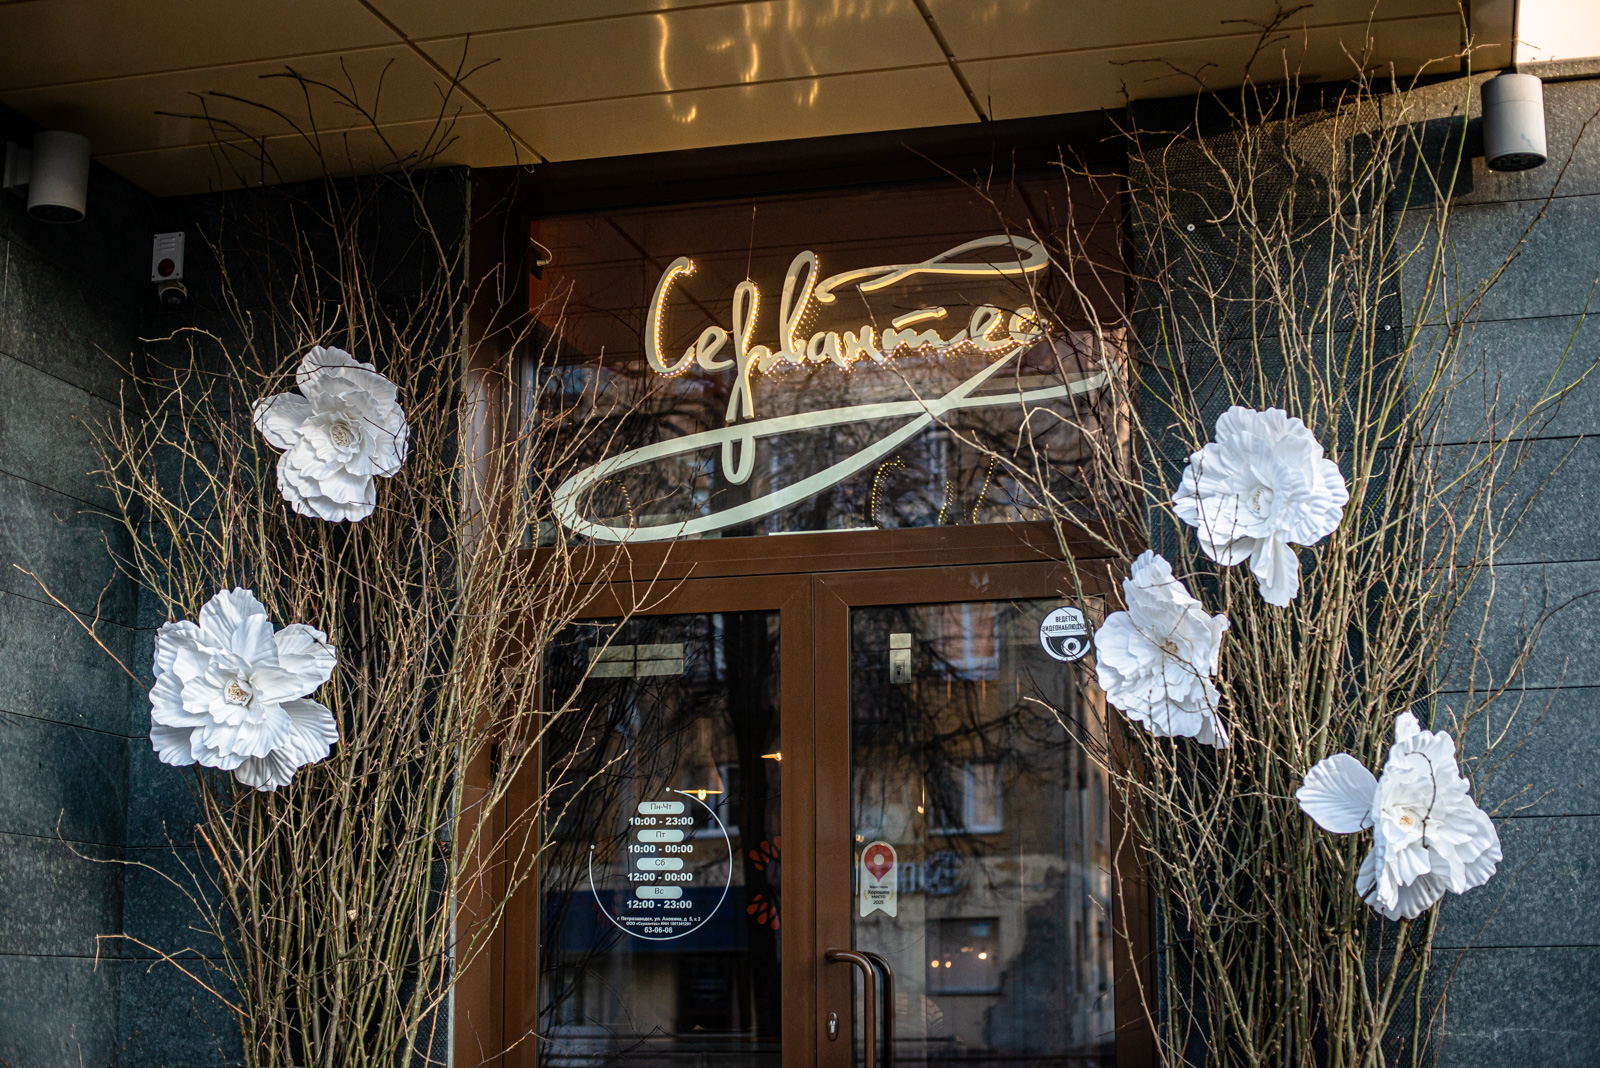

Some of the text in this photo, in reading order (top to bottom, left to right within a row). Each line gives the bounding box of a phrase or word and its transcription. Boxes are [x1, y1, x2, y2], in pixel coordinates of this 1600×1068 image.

[645, 250, 1053, 484] Сервантес
[1055, 615, 1078, 623] ВЕДЕТСЯ
[628, 817, 656, 826] 10:00
[665, 817, 694, 826] 23:00
[628, 844, 656, 853] 10:00
[664, 844, 693, 853] 00:00
[654, 859, 666, 867] Сб
[627, 872, 655, 881] 12:00
[664, 872, 693, 881] 00:00
[654, 887, 665, 895] Вс
[626, 900, 655, 909] 12:00
[663, 900, 692, 909] 23:00
